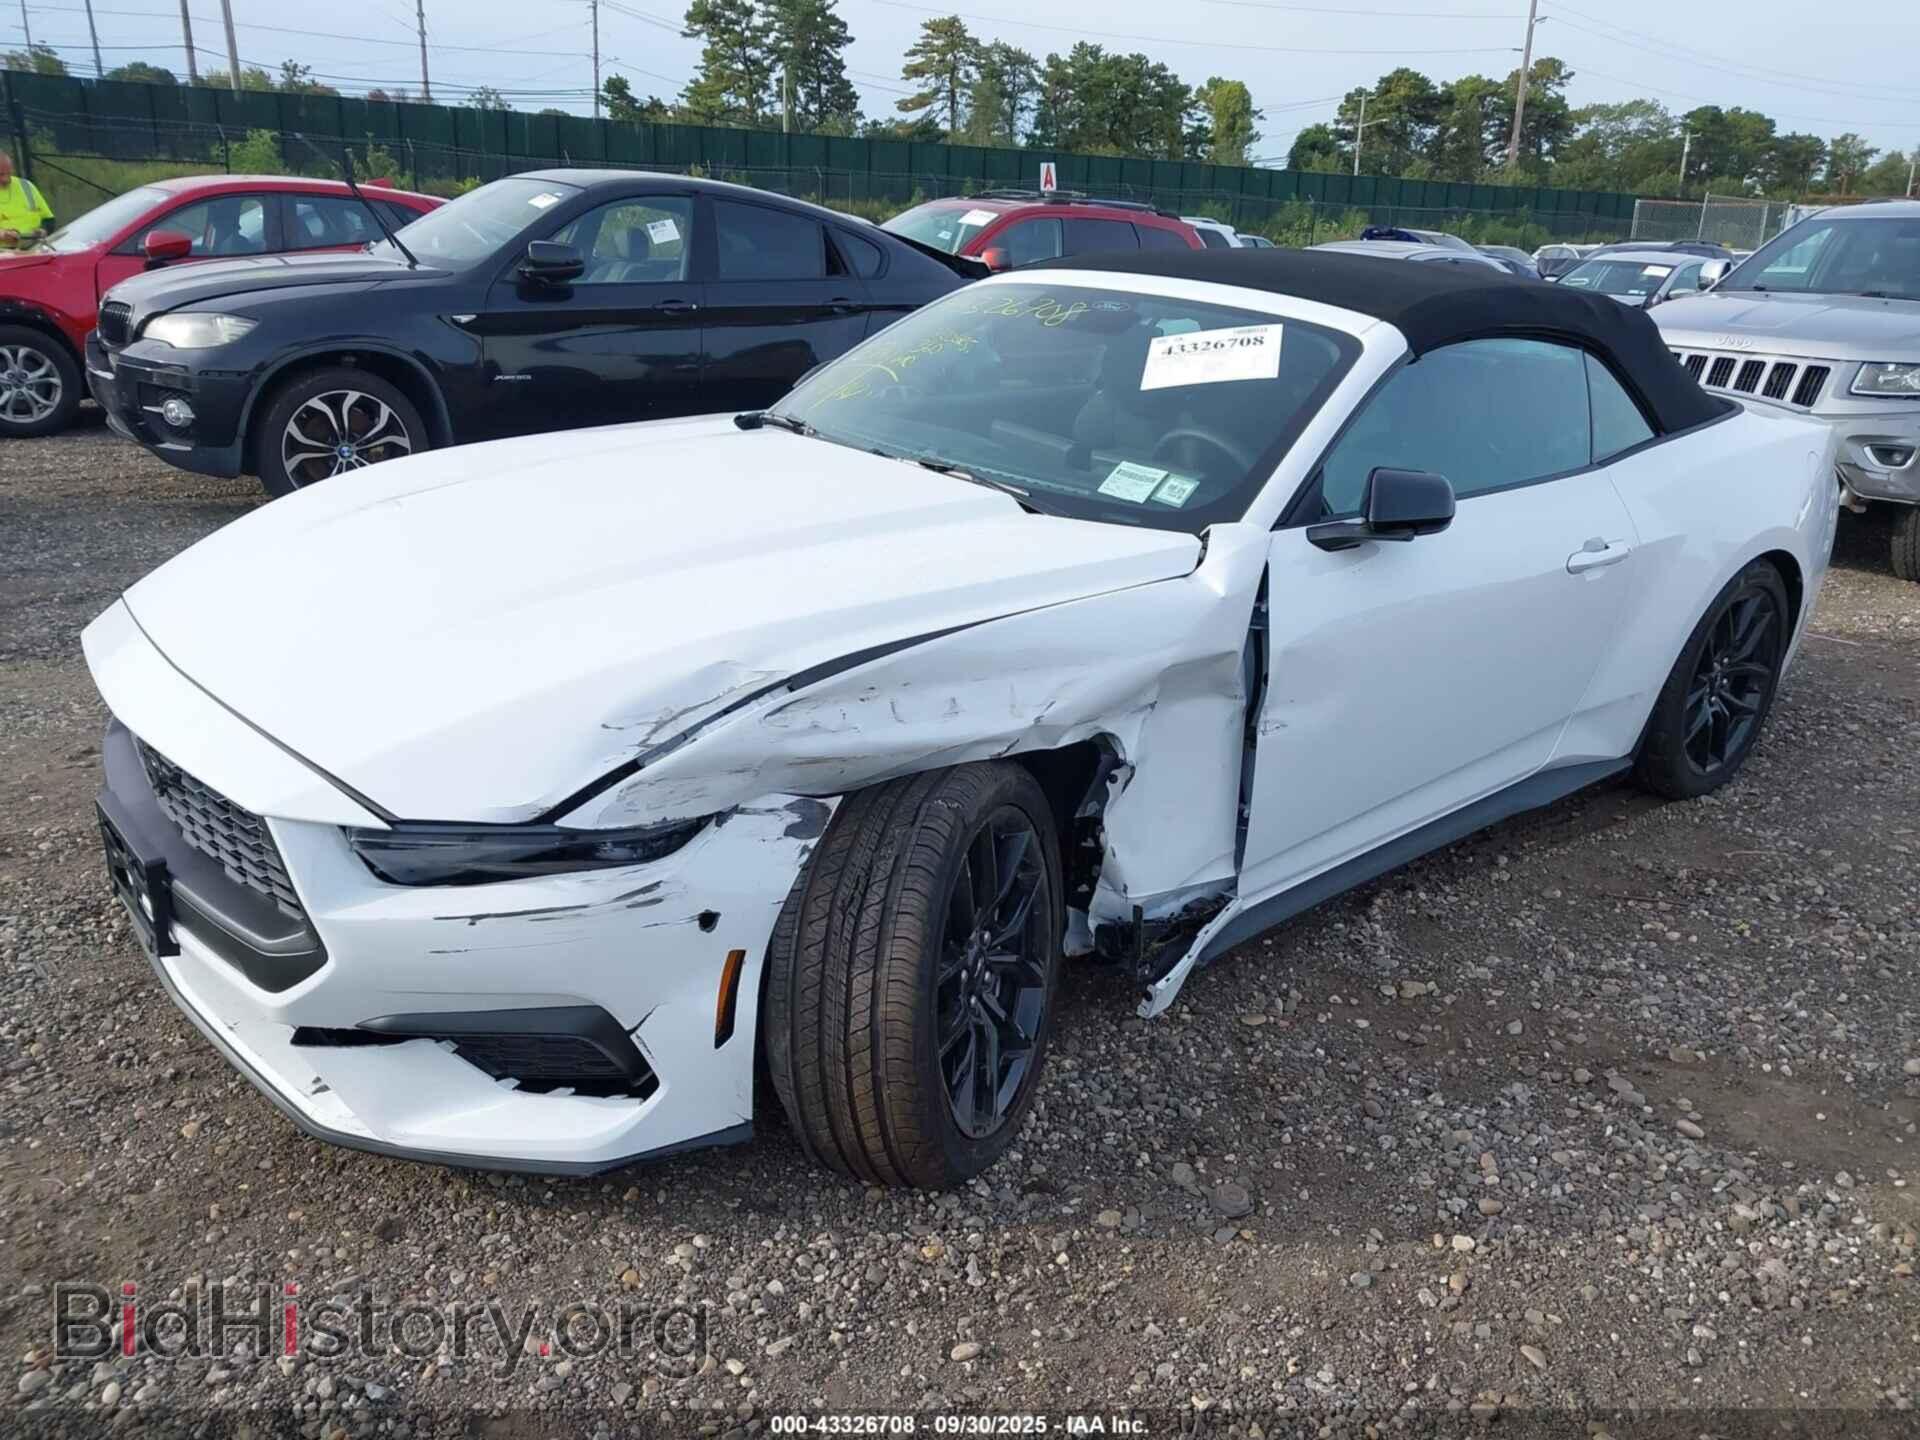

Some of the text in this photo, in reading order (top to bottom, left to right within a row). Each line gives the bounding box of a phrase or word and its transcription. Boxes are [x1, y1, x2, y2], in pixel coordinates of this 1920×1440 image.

[1043, 164, 1053, 189] A
[1161, 336, 1265, 356] 43326708
[1713, 335, 1753, 349] Jeep
